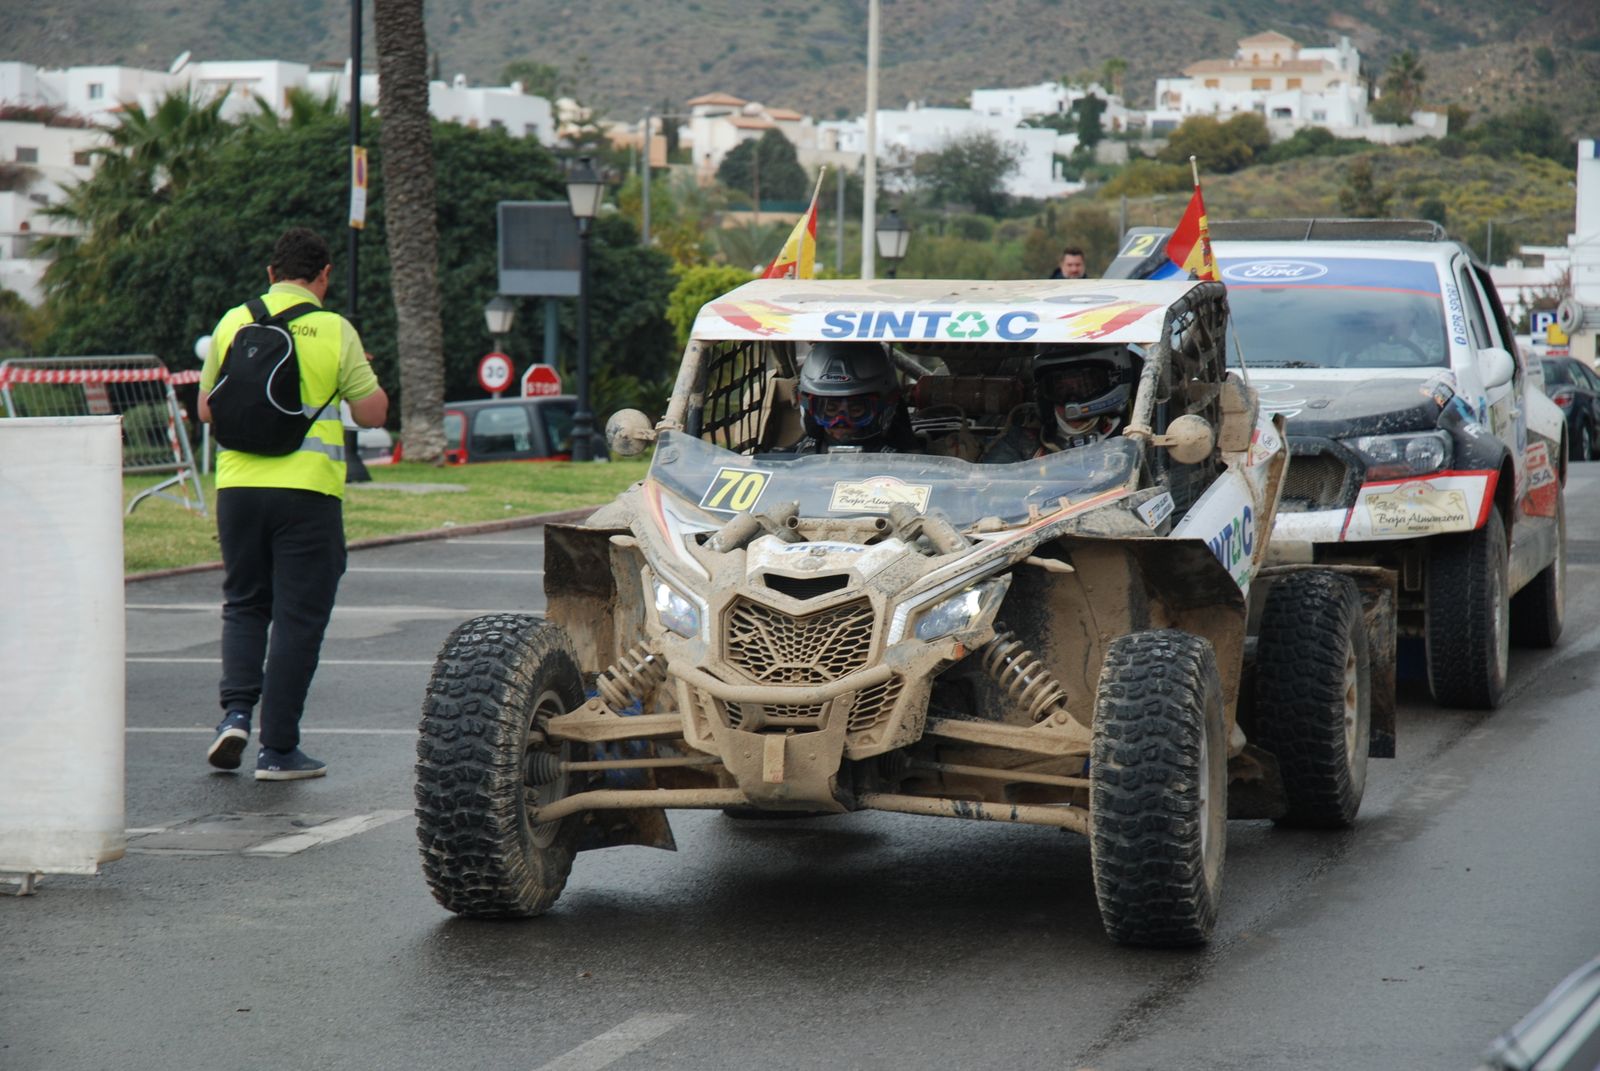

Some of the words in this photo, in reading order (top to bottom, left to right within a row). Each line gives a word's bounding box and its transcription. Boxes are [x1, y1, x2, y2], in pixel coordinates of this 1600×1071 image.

[1128, 235, 1154, 256] 2
[1244, 264, 1305, 277] Ford
[1452, 314, 1466, 335] GPR
[1537, 312, 1554, 334] P
[485, 365, 505, 379] 30
[708, 470, 766, 511] 70
[1377, 513, 1406, 527] Baja
